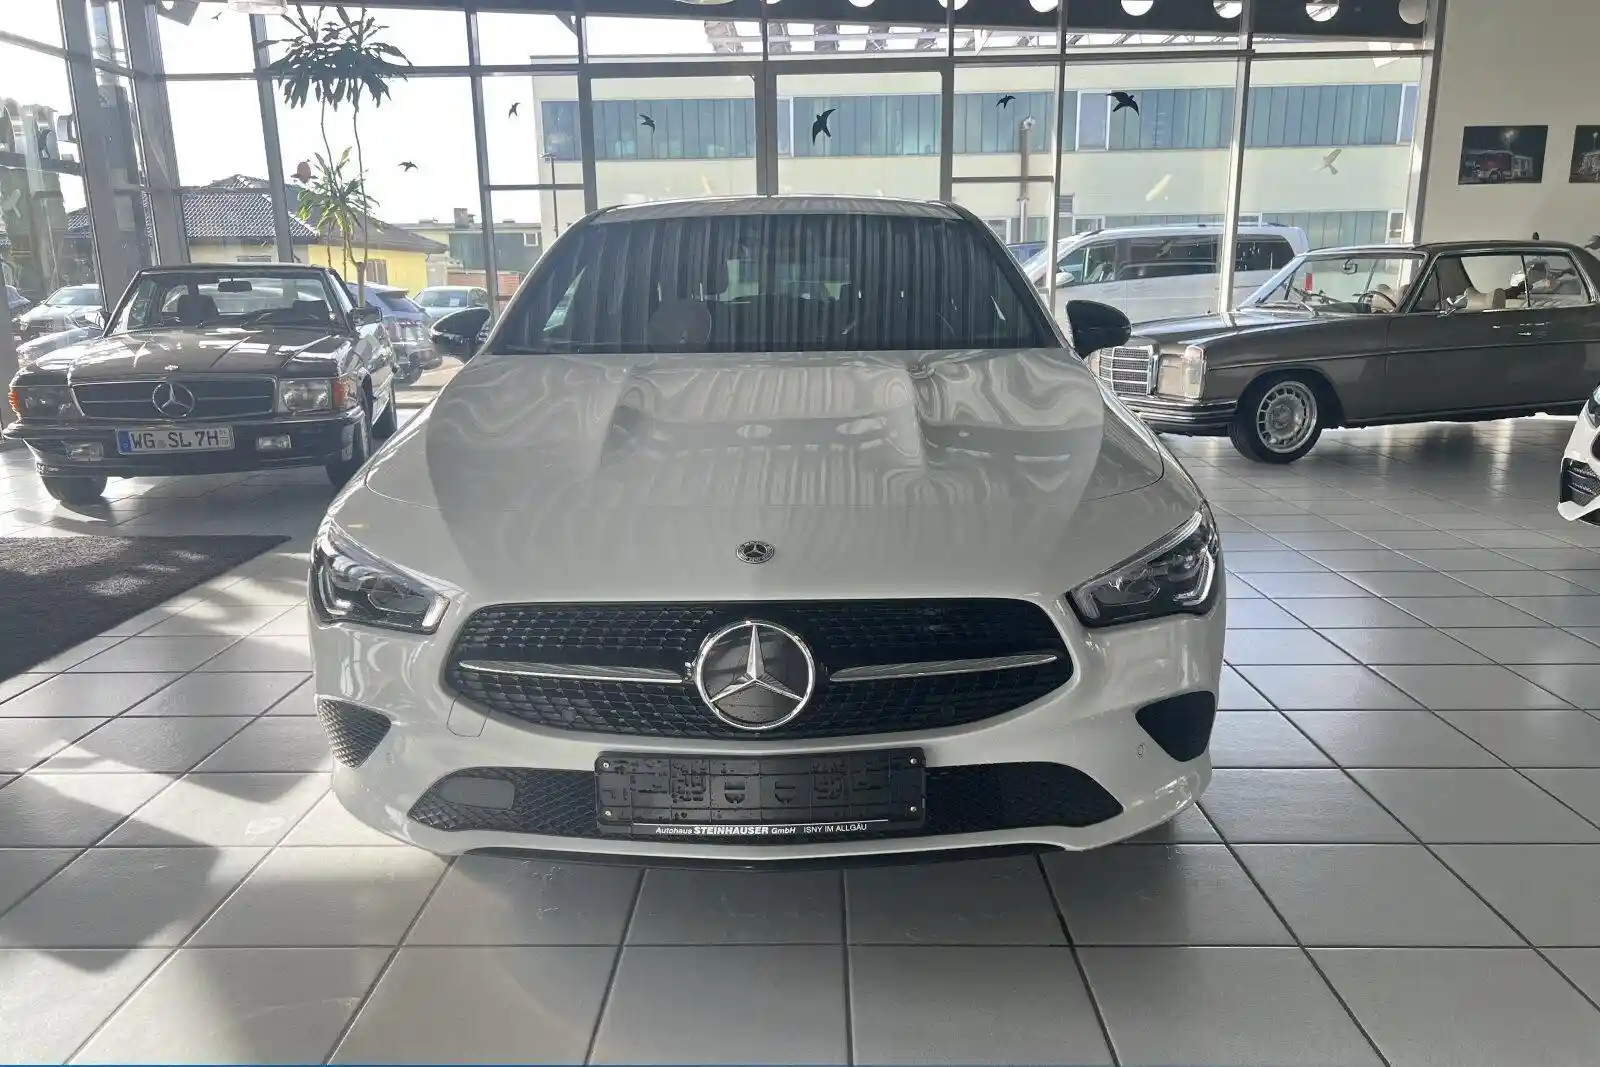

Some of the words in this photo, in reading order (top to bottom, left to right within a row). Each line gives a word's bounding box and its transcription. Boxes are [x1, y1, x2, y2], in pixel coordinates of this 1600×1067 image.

[131, 433, 156, 449] WG
[168, 432, 193, 449] SL
[195, 430, 219, 447] 7H
[655, 827, 693, 835] Autohaus
[693, 826, 770, 836] STEINHAUSER
[771, 827, 797, 835] GmbH
[803, 825, 823, 834] ISNY
[824, 825, 835, 833] IM
[836, 823, 868, 833] ALLGÄU
